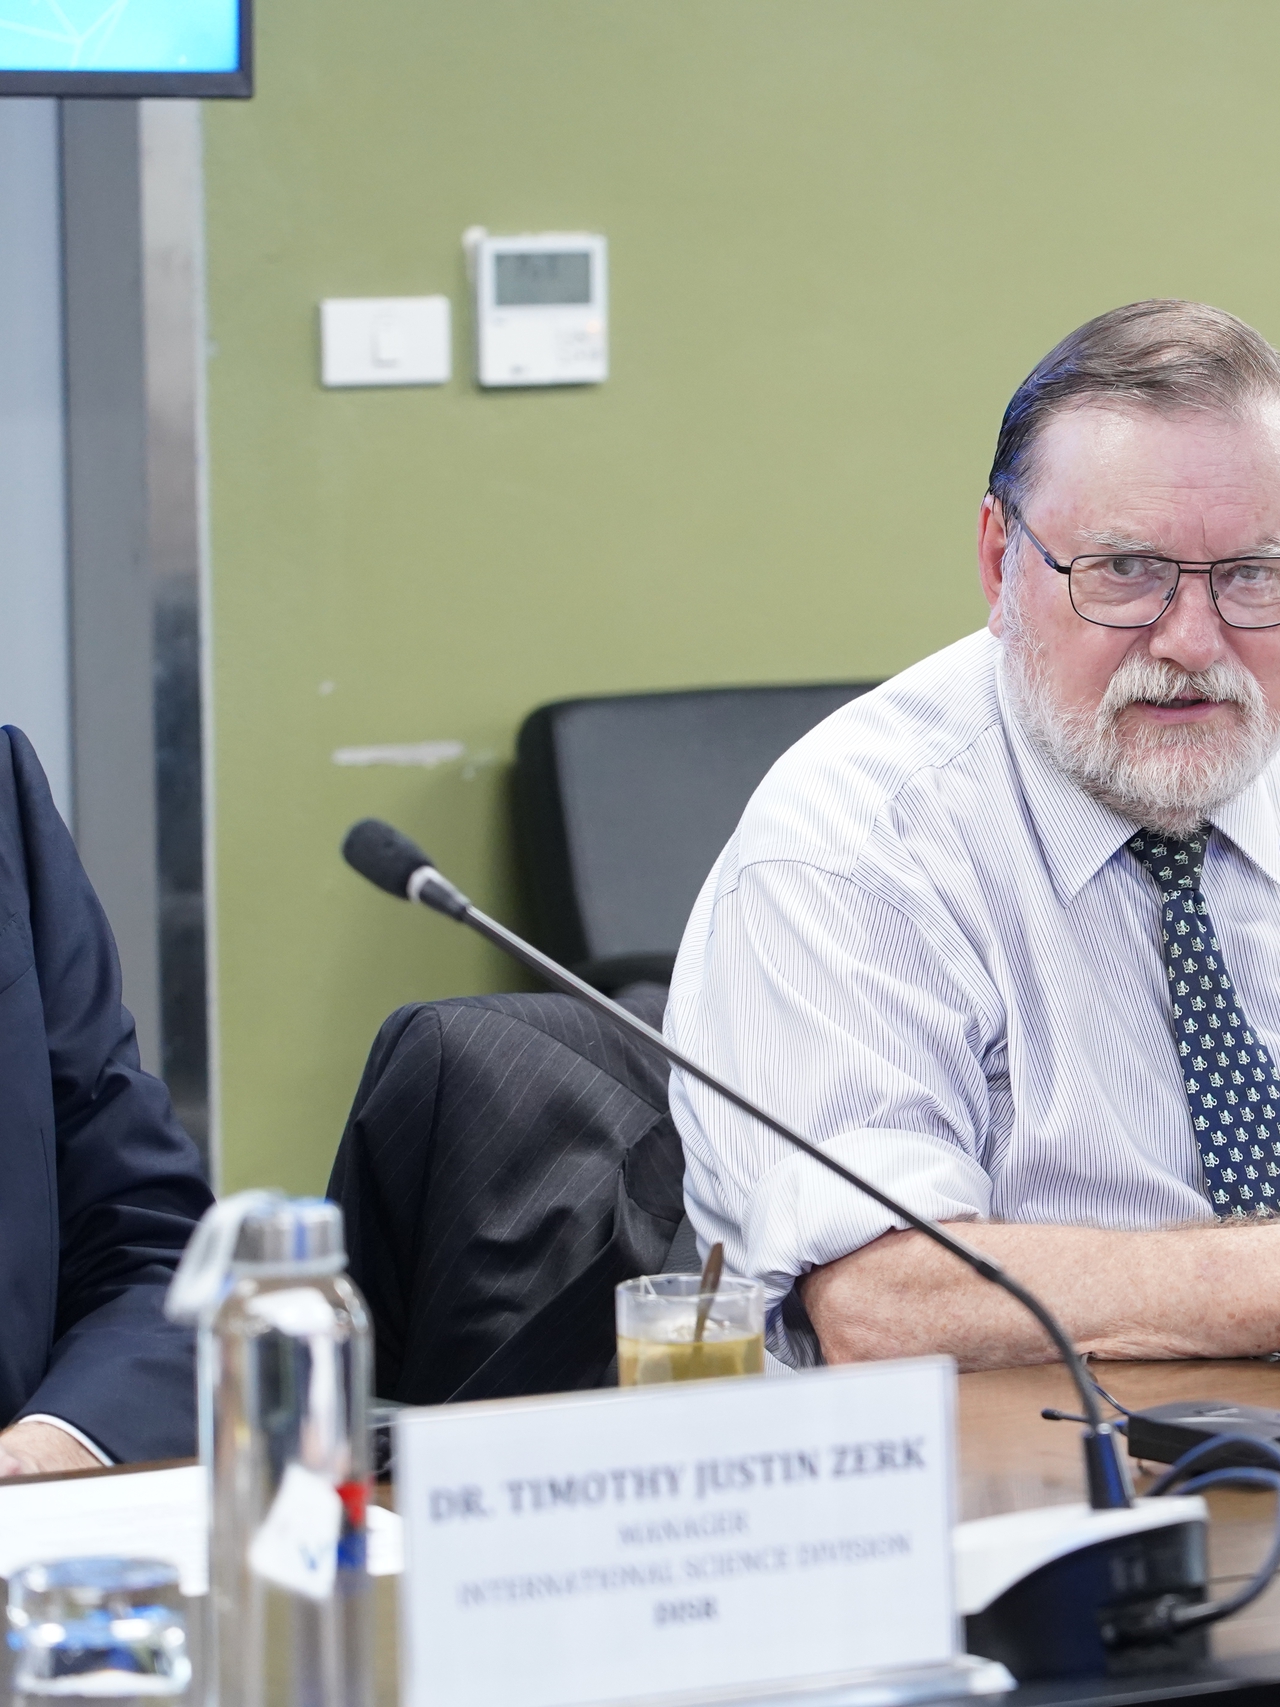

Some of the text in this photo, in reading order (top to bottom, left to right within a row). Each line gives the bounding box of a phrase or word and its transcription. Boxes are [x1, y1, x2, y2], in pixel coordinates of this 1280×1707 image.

[430, 1436, 926, 1523] DR. TIMOTHY JUSTIN ZERK
